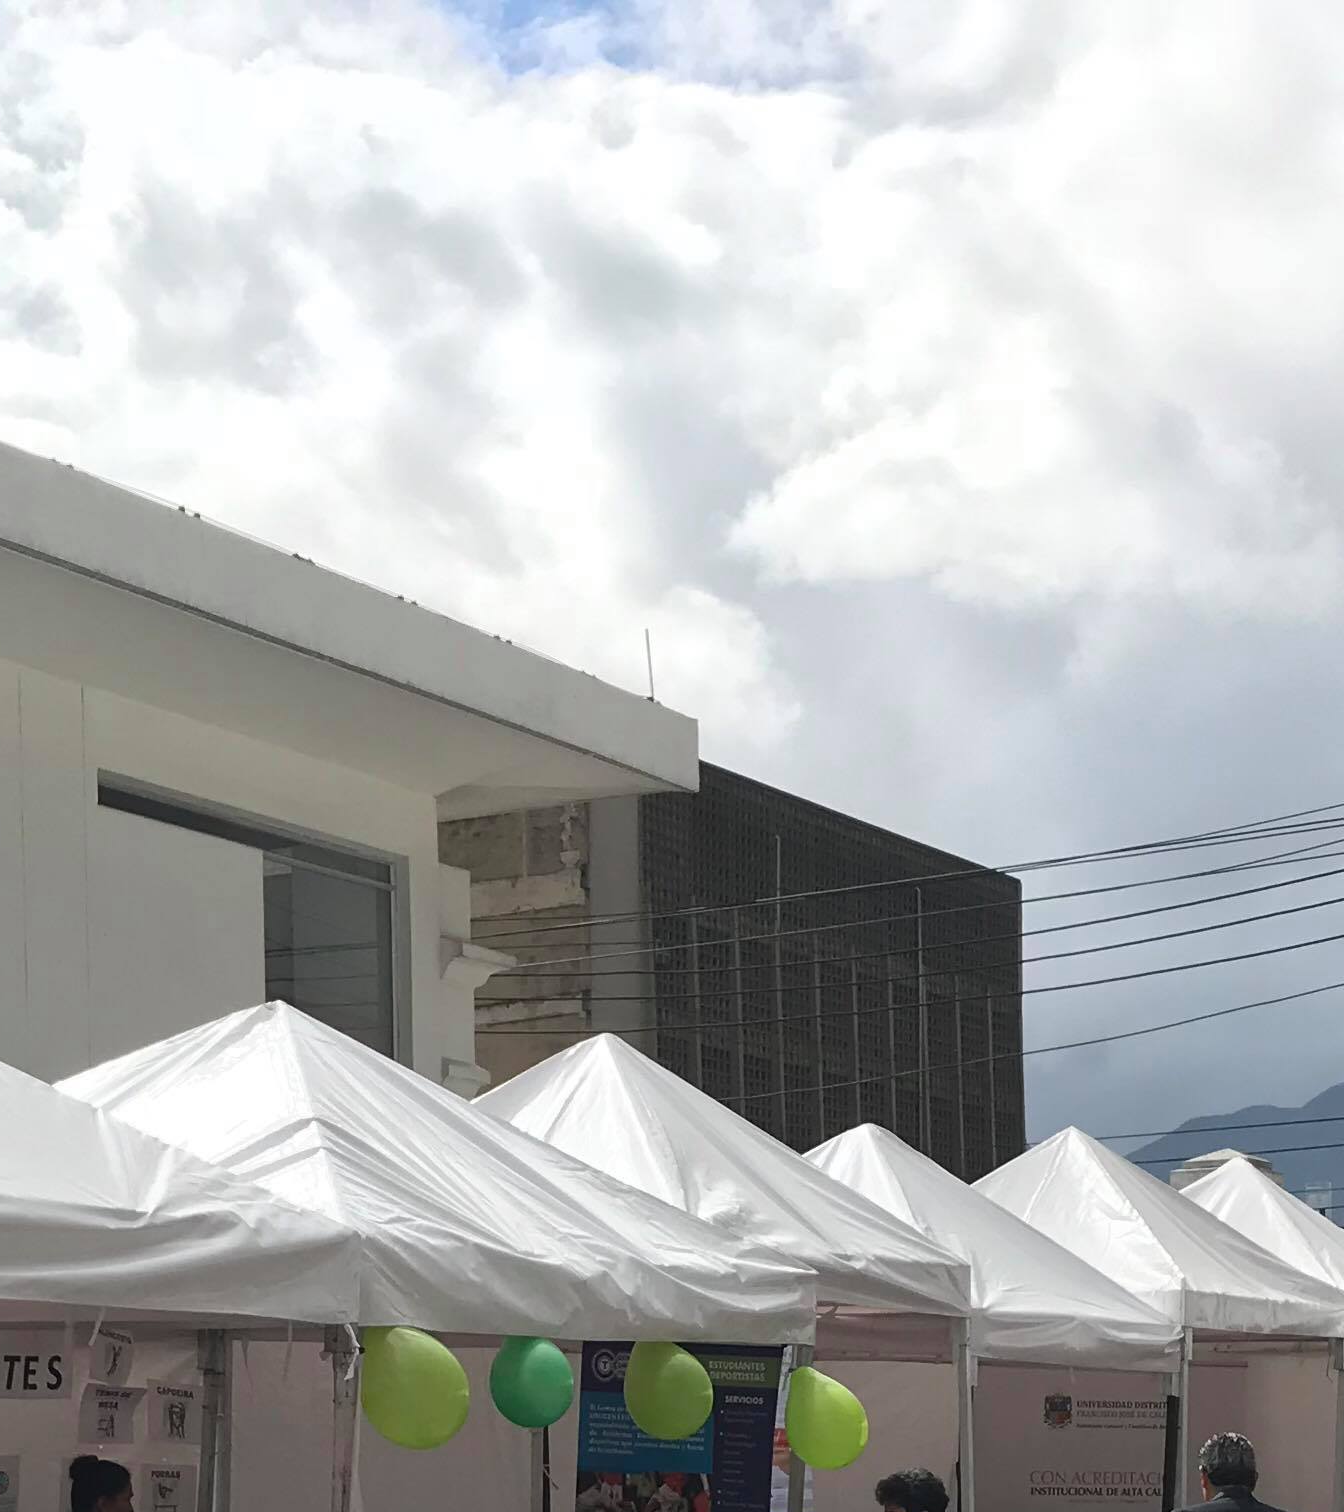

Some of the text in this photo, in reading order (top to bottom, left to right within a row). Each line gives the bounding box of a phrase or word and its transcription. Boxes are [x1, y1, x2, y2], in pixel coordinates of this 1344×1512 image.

[709, 1361, 766, 1371] ESTUDIANTES
[710, 1370, 766, 1382] DEPORTISTAS
[157, 1386, 194, 1399] CAPOEIRA
[724, 1395, 764, 1405] SERVICIOS
[1077, 1400, 1167, 1409] UNIVERSIDAD DISTRIT
[1030, 1470, 1161, 1486] CON ACREDITACI
[1030, 1487, 1162, 1496] INSTITUCIONAL DE ALTA CAL
